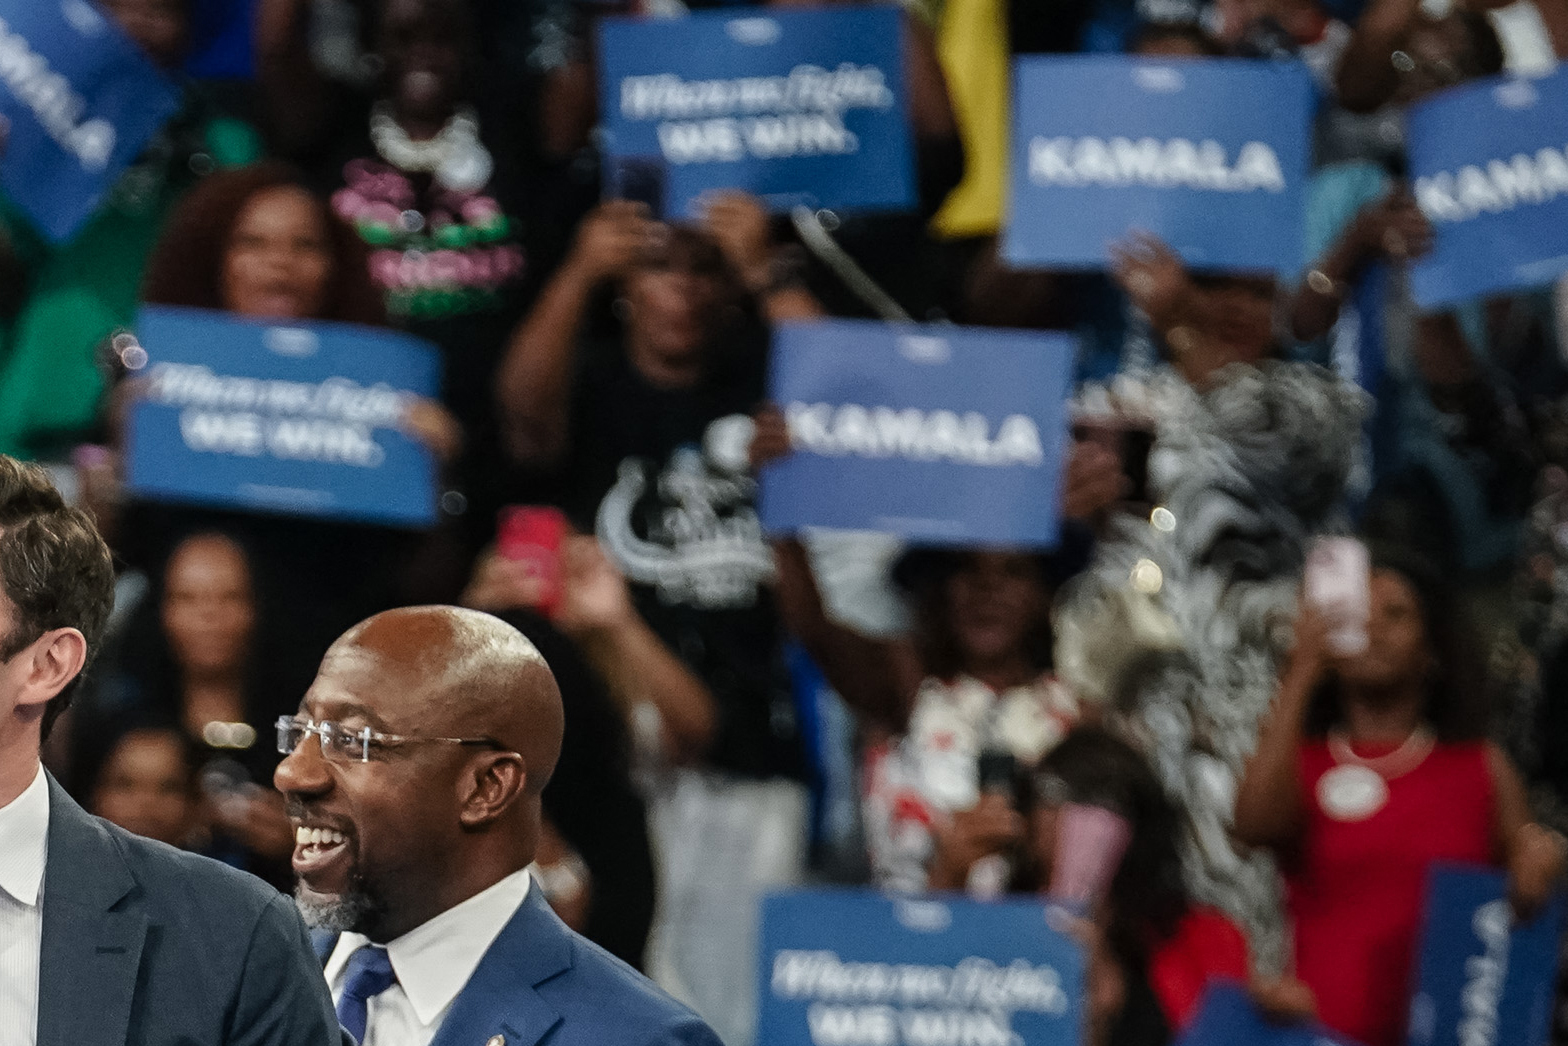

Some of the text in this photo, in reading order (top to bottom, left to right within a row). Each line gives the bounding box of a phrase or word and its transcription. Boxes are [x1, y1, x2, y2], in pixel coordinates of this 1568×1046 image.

[1029, 135, 1284, 192] KAMALA
[1413, 147, 1568, 222] KAMA
[785, 401, 1044, 468] KAMALA
